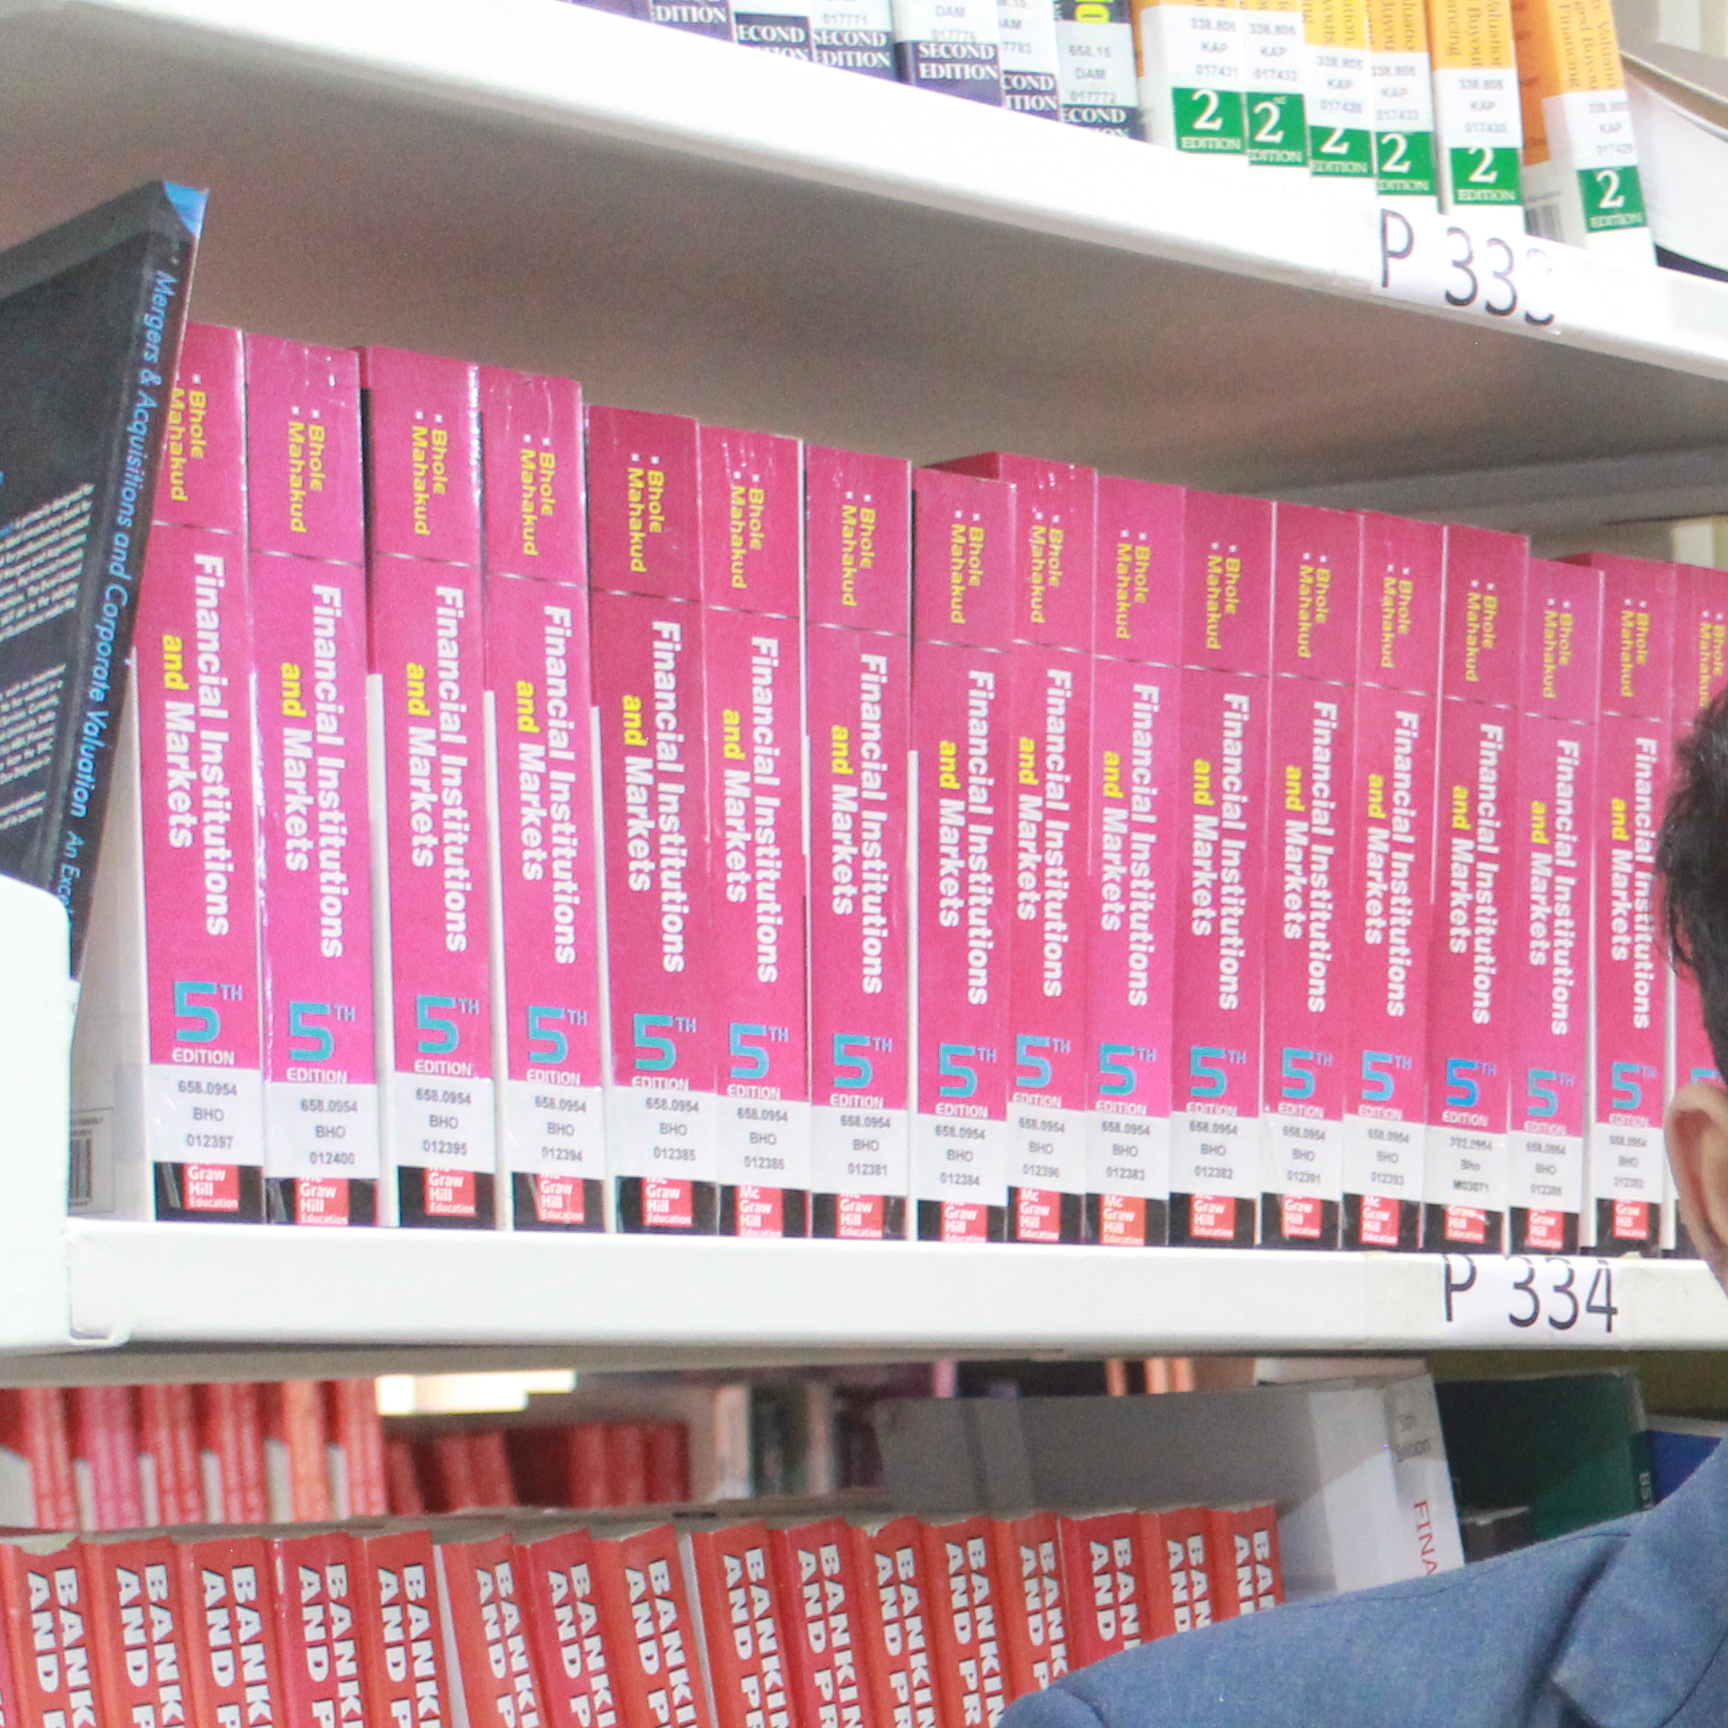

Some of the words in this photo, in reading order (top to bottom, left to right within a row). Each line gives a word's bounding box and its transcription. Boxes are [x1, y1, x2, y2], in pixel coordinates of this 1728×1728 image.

[918, 43, 995, 61] SECOND
[919, 64, 999, 80] EDITION
[1201, 41, 1228, 55] KAP
[1181, 137, 1242, 151] EDITION
[1381, 208, 1415, 289] P
[137, 268, 178, 367] Mergers
[119, 391, 159, 527] Acquisitions
[291, 422, 308, 534] Mahakud
[310, 425, 327, 491] Bhole
[411, 425, 430, 536] Mahakud
[431, 429, 447, 496] Bhole
[109, 531, 131, 580] and
[87, 581, 129, 701] Corporate
[194, 554, 229, 720] Financial
[1465, 593, 1483, 683] Mahakud
[1482, 593, 1498, 650] Bhole
[163, 635, 189, 690] and
[407, 664, 429, 716] and
[435, 586, 468, 745] Financial
[653, 621, 686, 775] Financial
[69, 700, 112, 818] Valuation
[624, 695, 649, 746] and
[833, 726, 855, 775] and
[860, 654, 889, 799] Financial
[165, 702, 198, 849] Markets
[408, 725, 440, 870] Markets
[1452, 787, 1472, 830] and
[1477, 723, 1504, 852] Financial
[198, 728, 229, 936] Institutions
[440, 753, 467, 953] Institutions
[625, 756, 656, 891] Markets
[831, 784, 859, 916] Markets
[656, 781, 688, 973] Institutions
[862, 806, 890, 994] Institutions
[1449, 837, 1474, 953] Markets
[1472, 857, 1498, 1025] Institutions
[172, 1049, 235, 1066] EDITION
[178, 1080, 238, 1097] 658.0954
[186, 1134, 233, 1149] 012397
[193, 1108, 225, 1122] BHO
[301, 1099, 358, 1113] 658.0954
[315, 1125, 346, 1139] BHO
[935, 1103, 989, 1119] EDITION
[187, 1167, 226, 1182] Graw
[188, 1180, 214, 1196] Hill
[310, 1151, 356, 1166] 012400
[190, 1197, 238, 1209] Education
[1443, 1254, 1477, 1322] P
[1508, 1256, 1618, 1334] 334
[27, 1570, 60, 1694] AND
[202, 1569, 236, 1688] AND
[798, 1549, 828, 1654] AND
